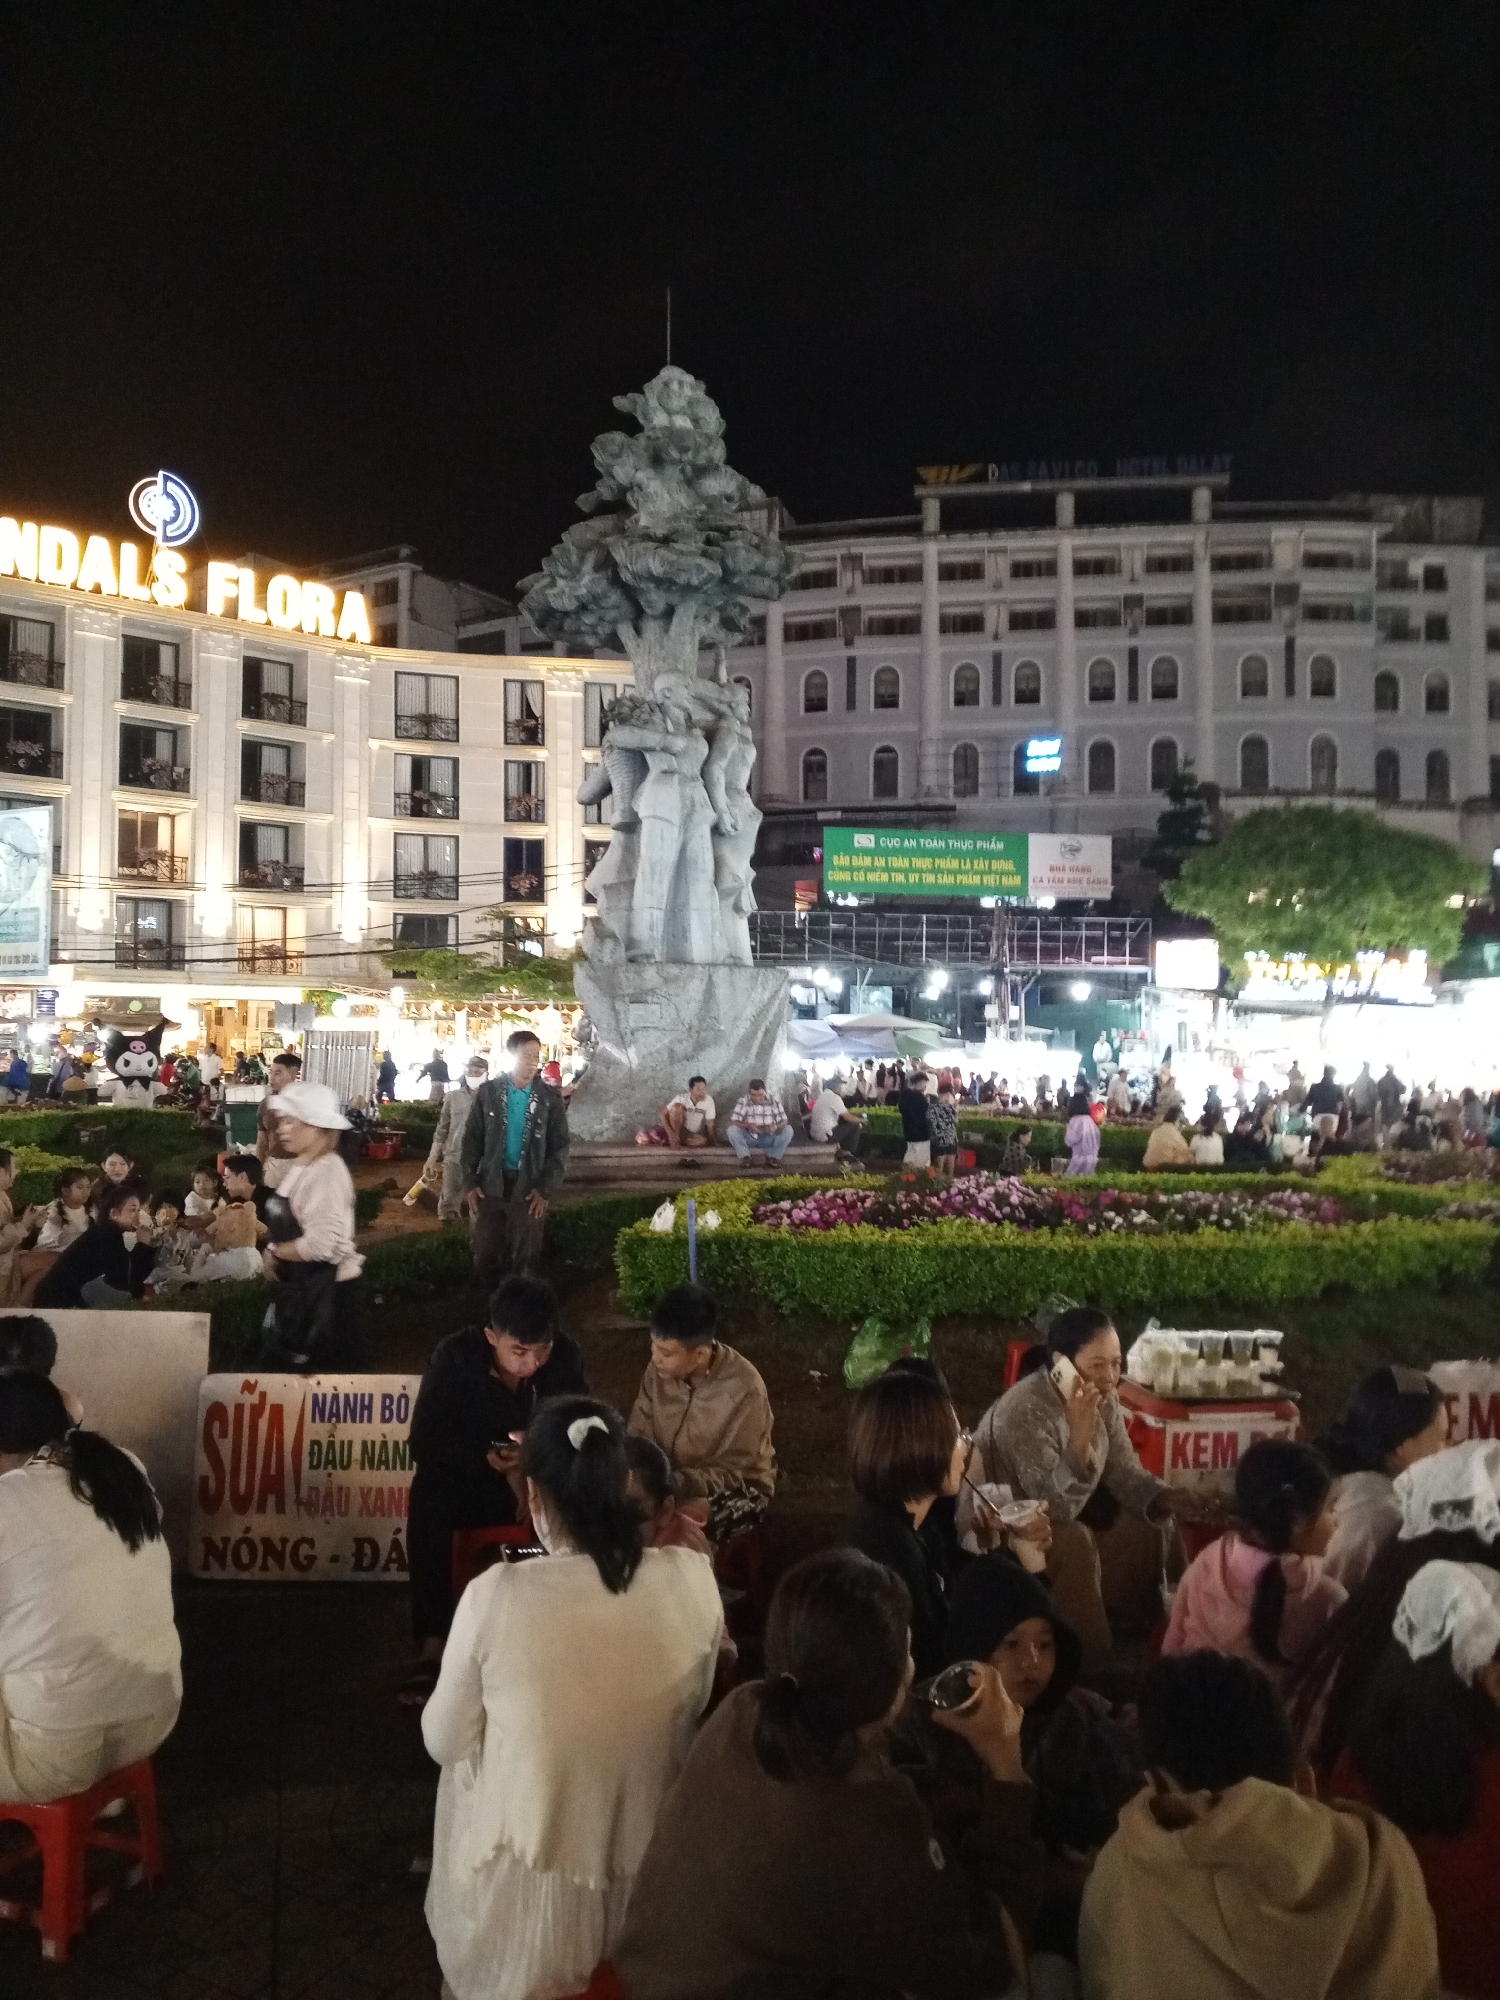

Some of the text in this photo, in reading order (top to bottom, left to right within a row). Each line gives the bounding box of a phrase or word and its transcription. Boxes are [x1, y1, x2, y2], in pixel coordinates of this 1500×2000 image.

[207, 561, 372, 644] FLORA
[874, 855, 886, 867] AN
[888, 854, 909, 868] TOÀN
[879, 836, 901, 849] CỤC
[904, 837, 917, 848] AN
[919, 837, 945, 849] TOÀN
[976, 836, 1004, 851] PHẨM
[909, 872, 919, 883] UY
[983, 873, 1000, 888] VIỆT
[1001, 874, 1021, 887] NAM
[311, 1385, 410, 1424] NÀNH BÒ
[1444, 1391, 1500, 1440] EM
[200, 1379, 286, 1516] SỮA
[308, 1433, 353, 1478] ĐẬU
[1171, 1431, 1239, 1470] KEM
[201, 1527, 317, 1573] NÓNG
[351, 1527, 410, 1573] ĐÁ
